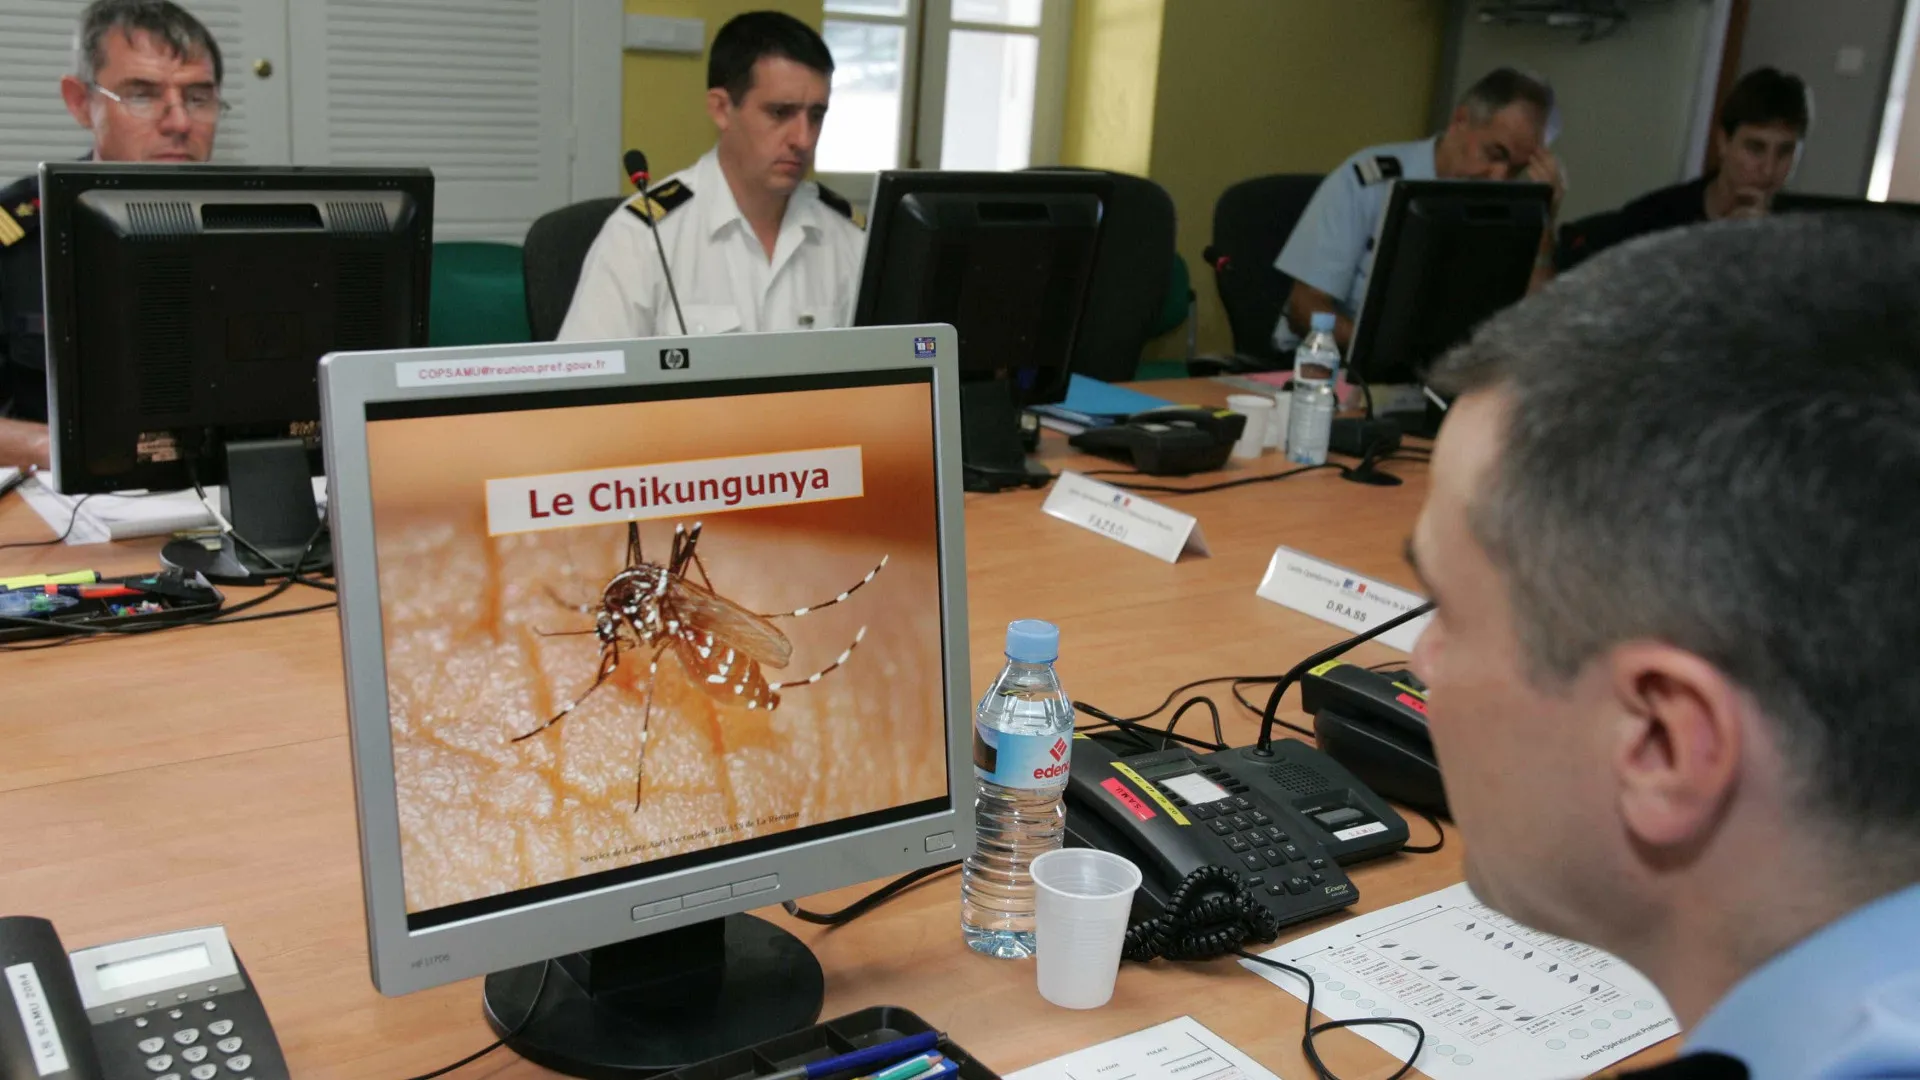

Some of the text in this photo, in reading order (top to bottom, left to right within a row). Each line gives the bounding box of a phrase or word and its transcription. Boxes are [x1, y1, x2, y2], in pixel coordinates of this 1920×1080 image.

[528, 467, 829, 519] Le Chikungunya
[1033, 761, 1070, 780] eden
[1581, 1047, 1605, 1060] Centre
